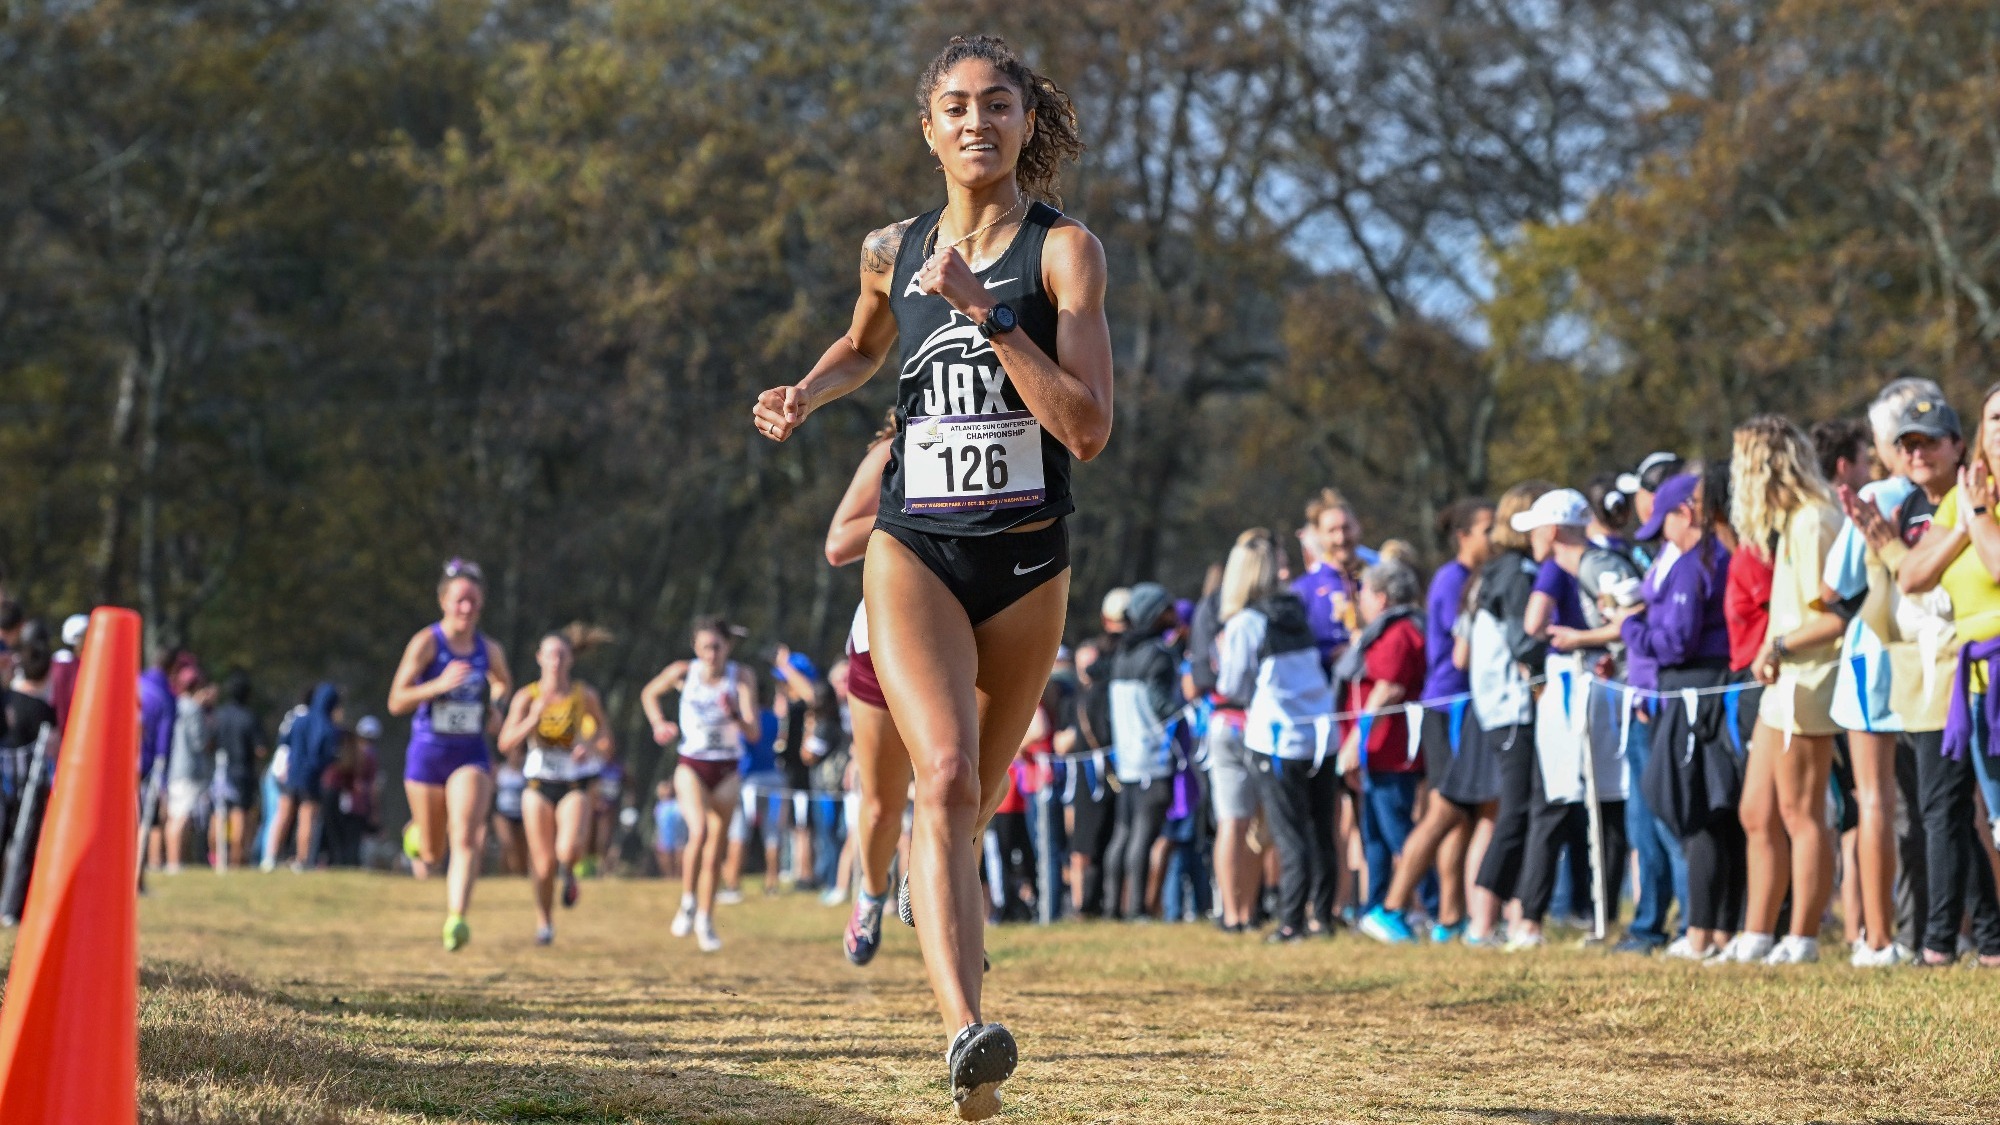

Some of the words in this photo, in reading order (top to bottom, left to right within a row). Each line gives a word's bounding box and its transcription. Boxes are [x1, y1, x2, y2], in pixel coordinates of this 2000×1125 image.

[924, 361, 1009, 415] JAX
[950, 424, 982, 432] ATLANTIC
[996, 419, 1038, 429] CONFERENCE
[966, 428, 1026, 440] CHAMPIONSHIP
[937, 443, 1009, 492] 126
